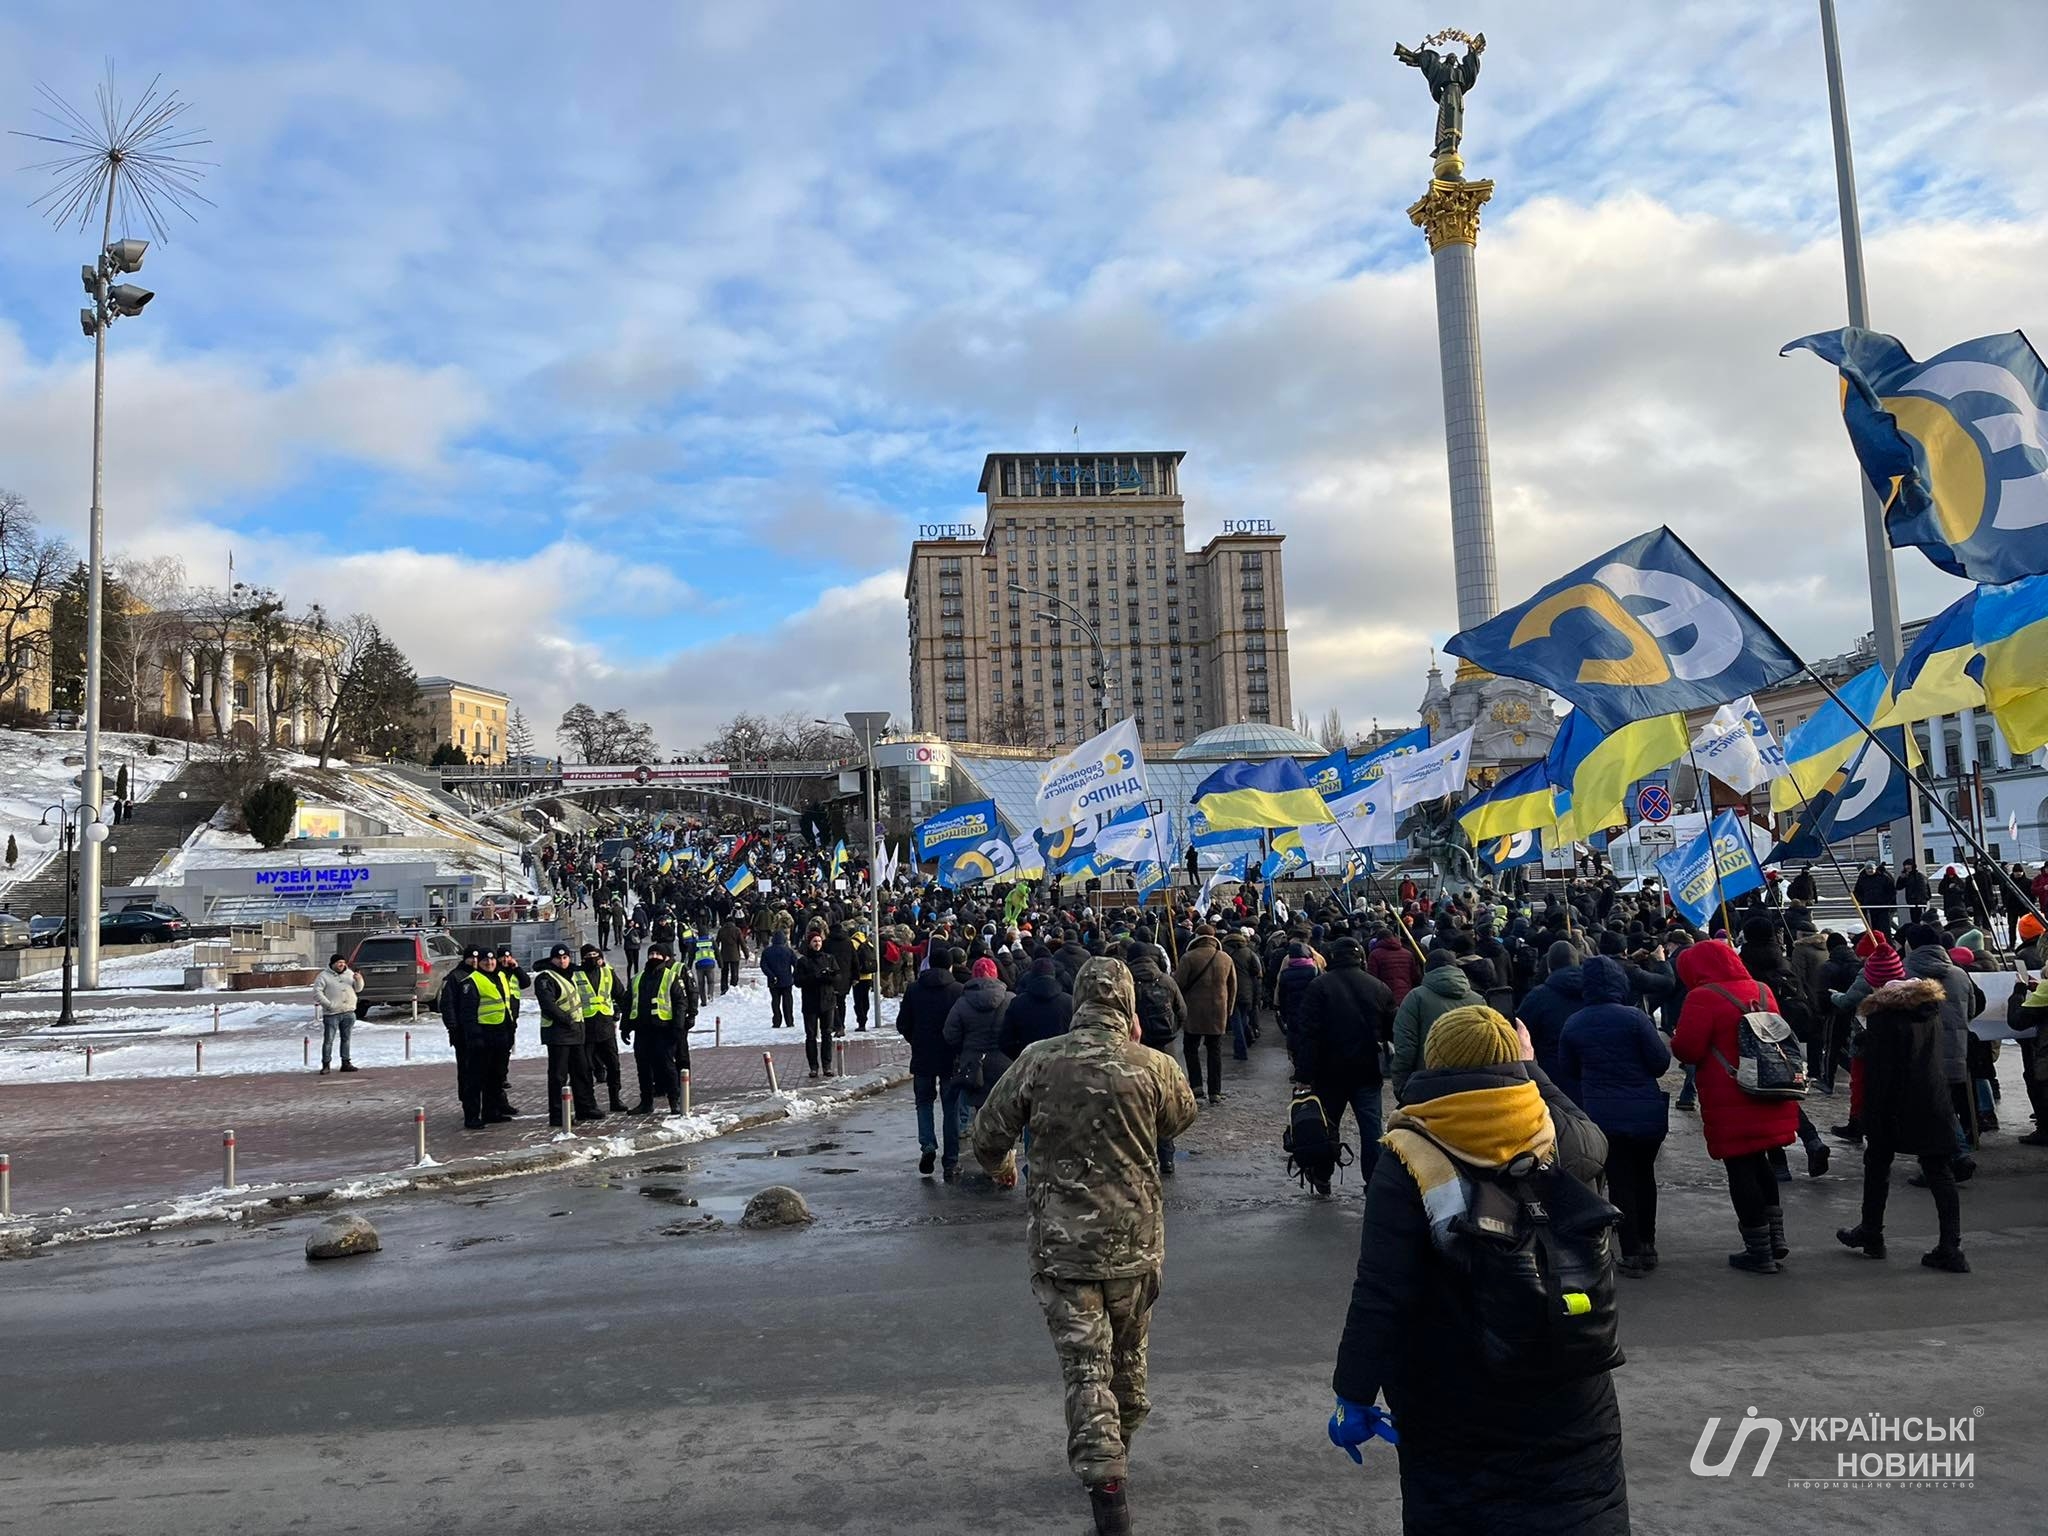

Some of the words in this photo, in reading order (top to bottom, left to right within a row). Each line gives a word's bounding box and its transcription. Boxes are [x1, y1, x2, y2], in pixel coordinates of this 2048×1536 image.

[1033, 463, 1142, 484] УКРАЇНА
[919, 524, 976, 537] ГОТЕЛЬ
[1223, 519, 1275, 532] HOTEL
[906, 747, 946, 762] GLOBUS
[256, 868, 312, 885] МУЗЕЙ
[316, 868, 369, 883] МЕДУЗ
